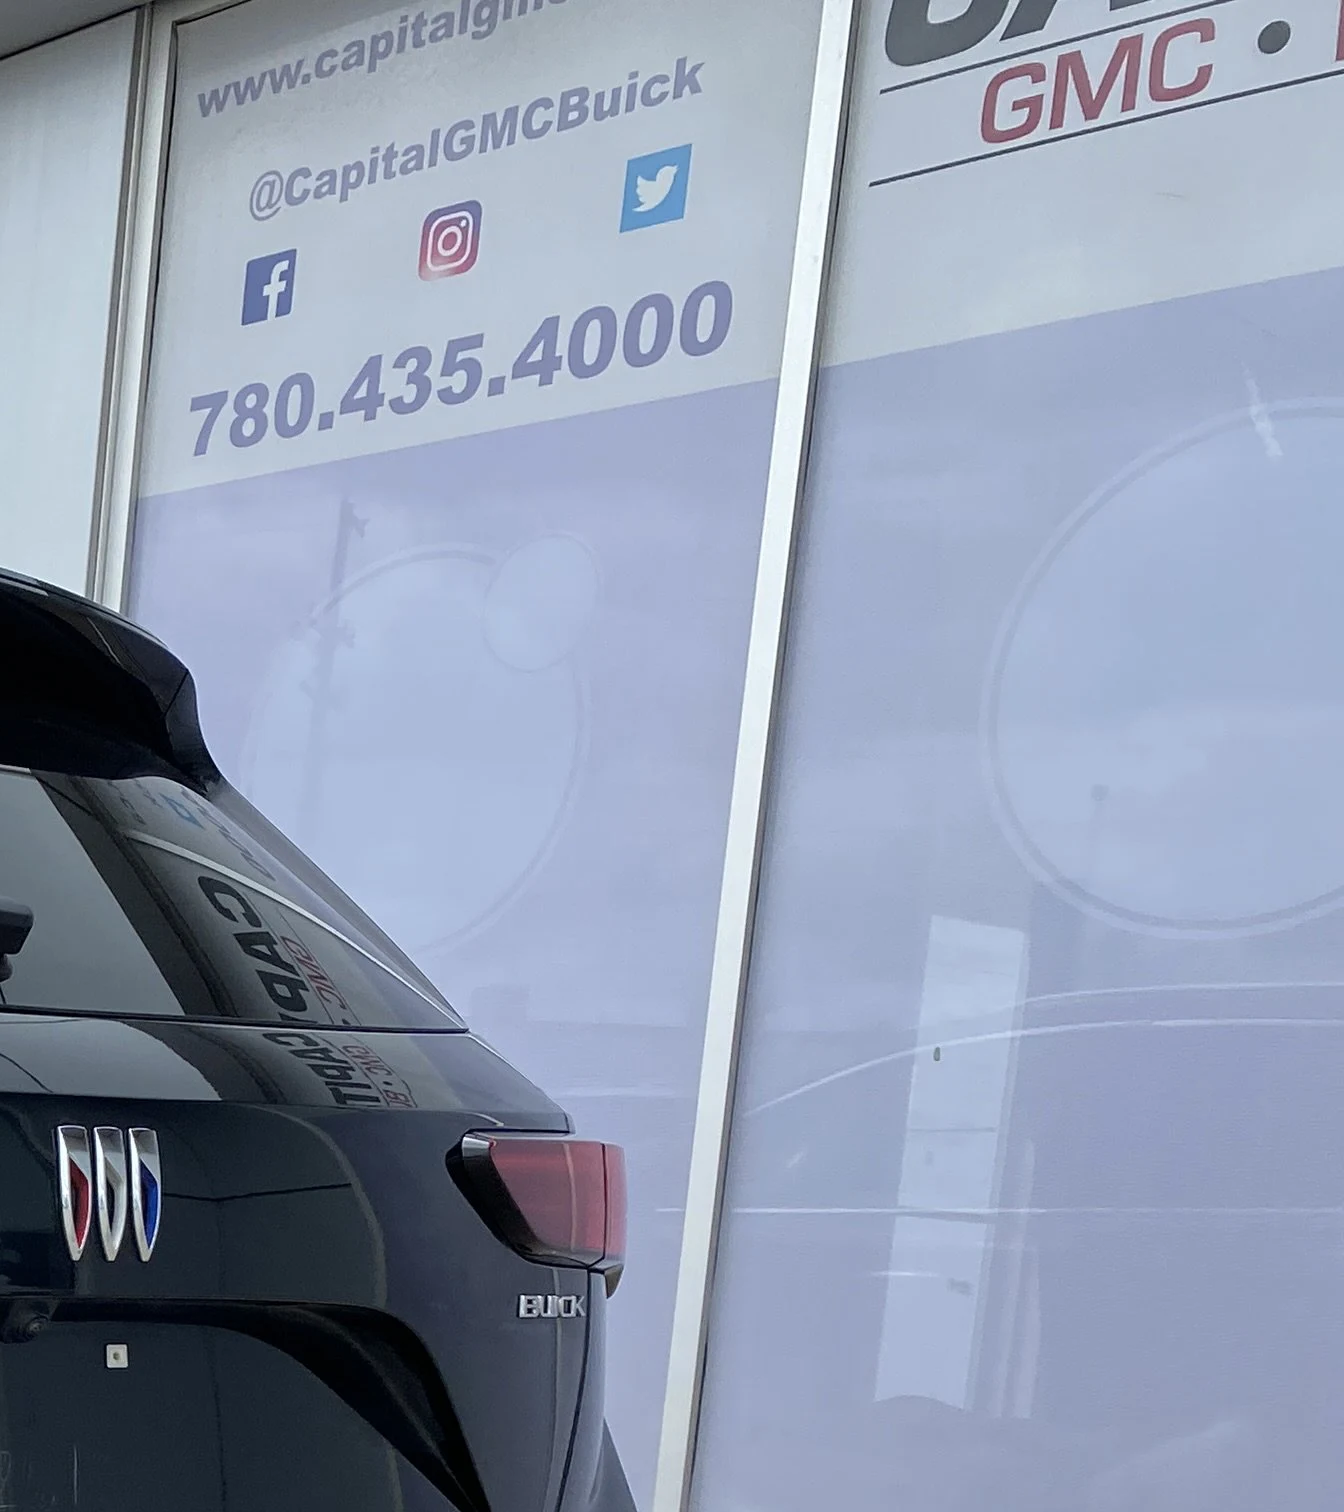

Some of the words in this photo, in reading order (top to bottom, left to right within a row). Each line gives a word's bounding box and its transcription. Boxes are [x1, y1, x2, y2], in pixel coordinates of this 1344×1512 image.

[249, 56, 706, 221] @CapitalGMCBuick
[980, 17, 1217, 144] GMC
[189, 280, 734, 457] 780.435.4000
[518, 1294, 587, 1319] BUICK
